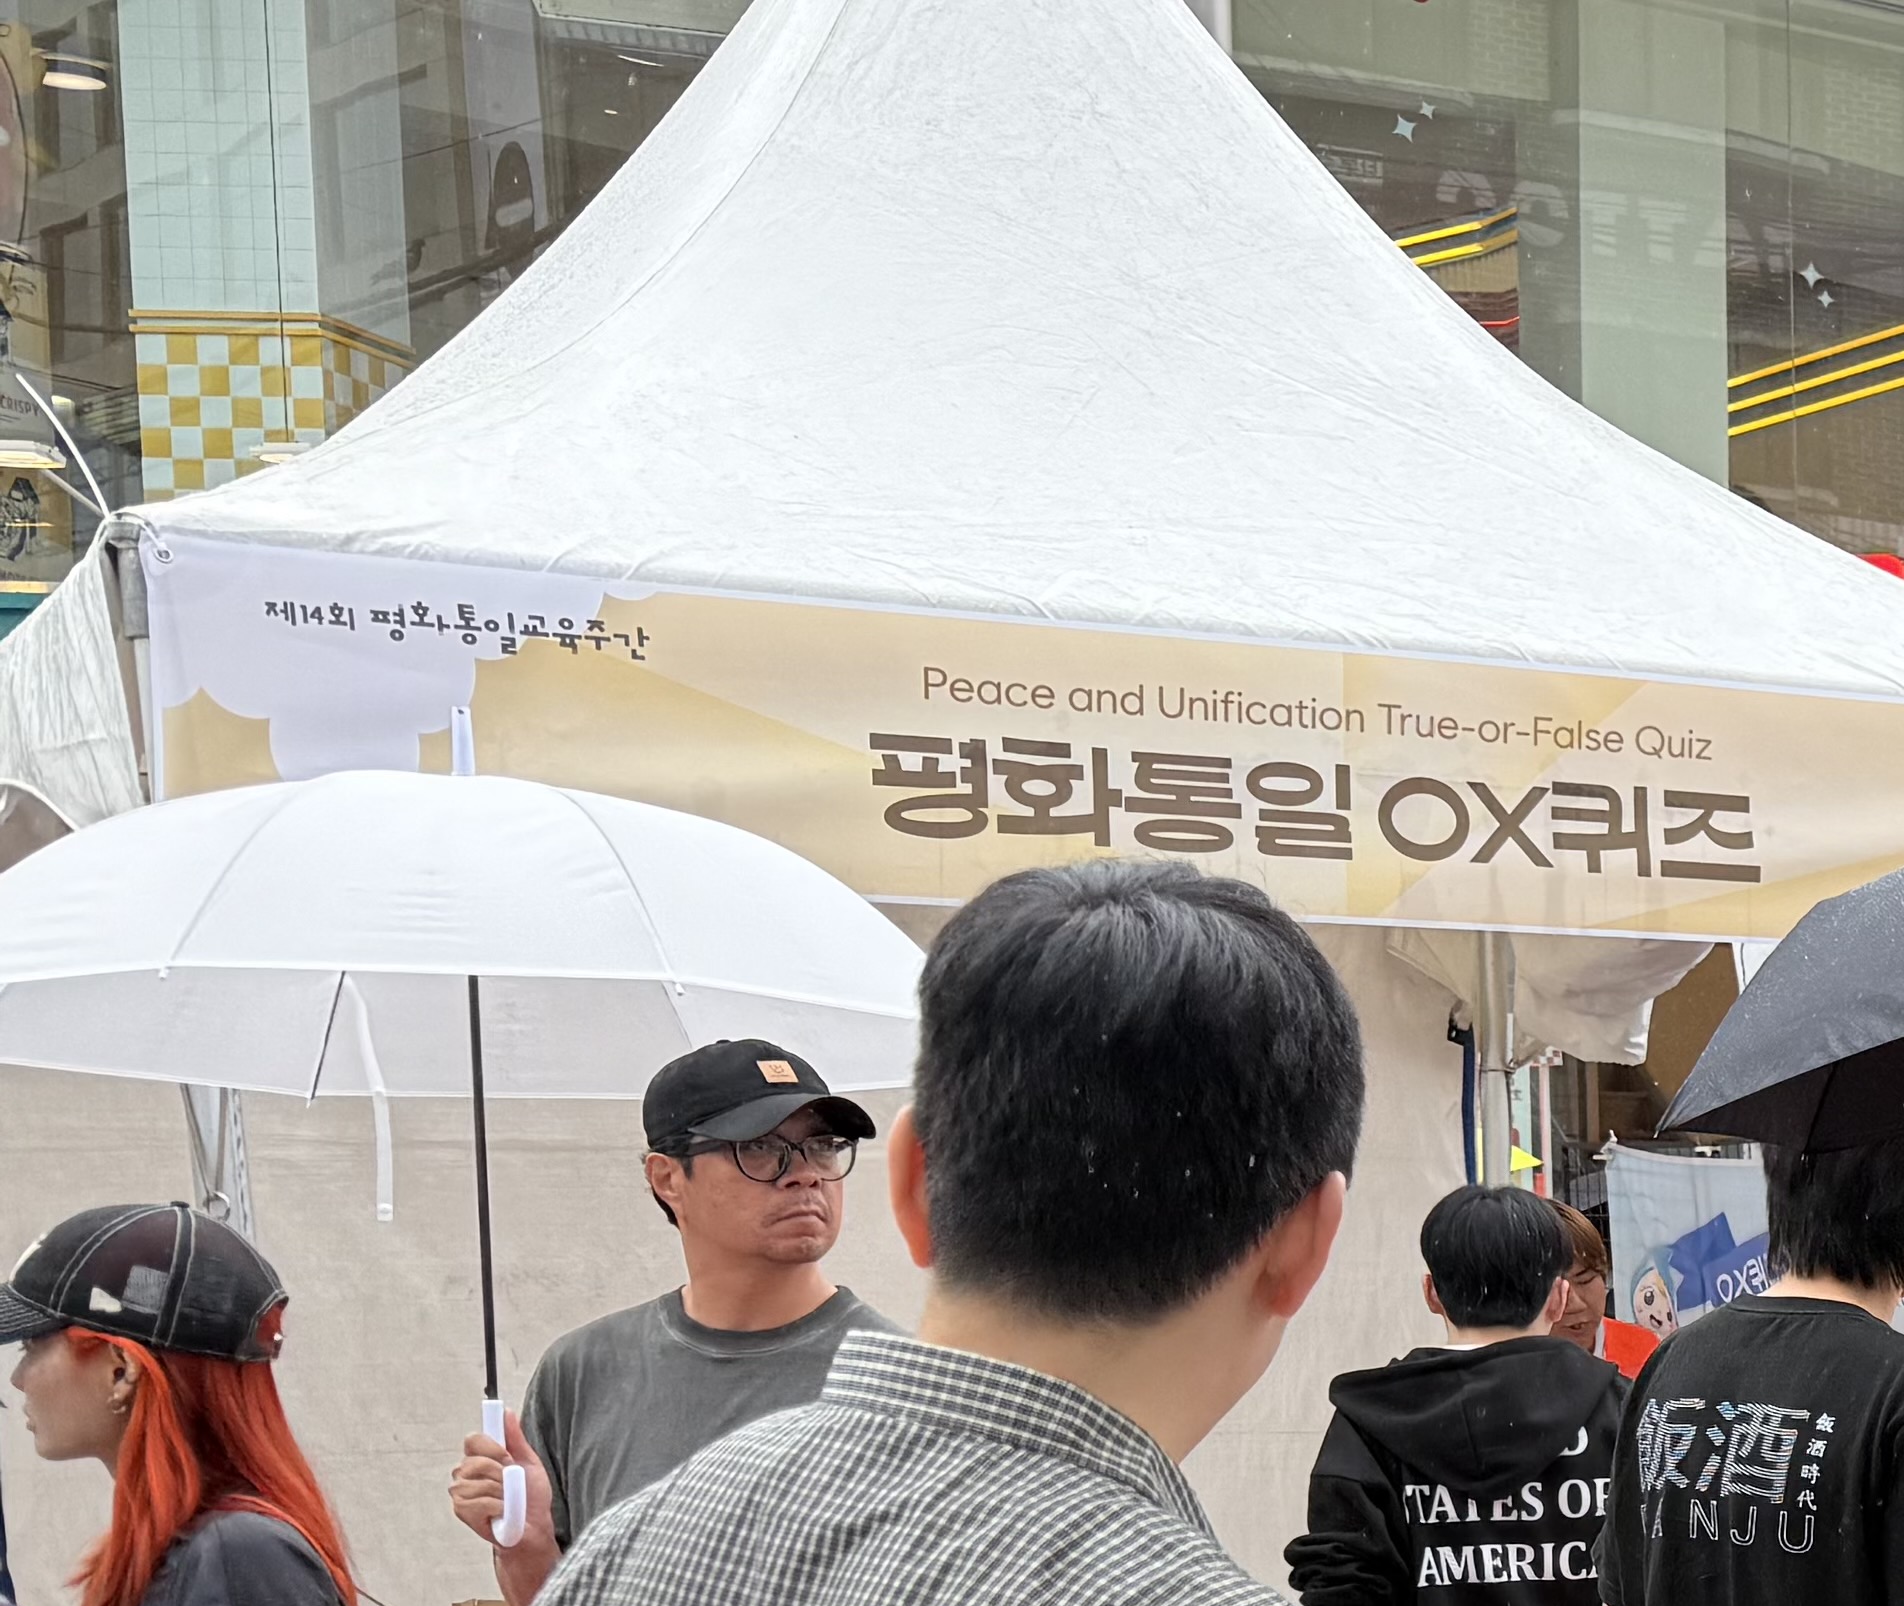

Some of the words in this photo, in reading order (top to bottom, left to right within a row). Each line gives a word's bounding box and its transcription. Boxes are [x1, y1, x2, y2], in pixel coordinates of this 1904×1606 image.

[265, 600, 356, 631] 제14회
[369, 600, 651, 661] 평화통일교육주간
[922, 666, 1056, 711] Peace
[1067, 683, 1145, 718] and
[1157, 685, 1366, 734] Unification
[1376, 704, 1625, 754] True-or-False
[1634, 725, 1713, 761] Quiz
[869, 732, 1354, 861] 평화통일
[1377, 776, 1762, 883] OX퀴즈
[1402, 1481, 1545, 1524] TAES
[1416, 1540, 1599, 1588] AMERIC
